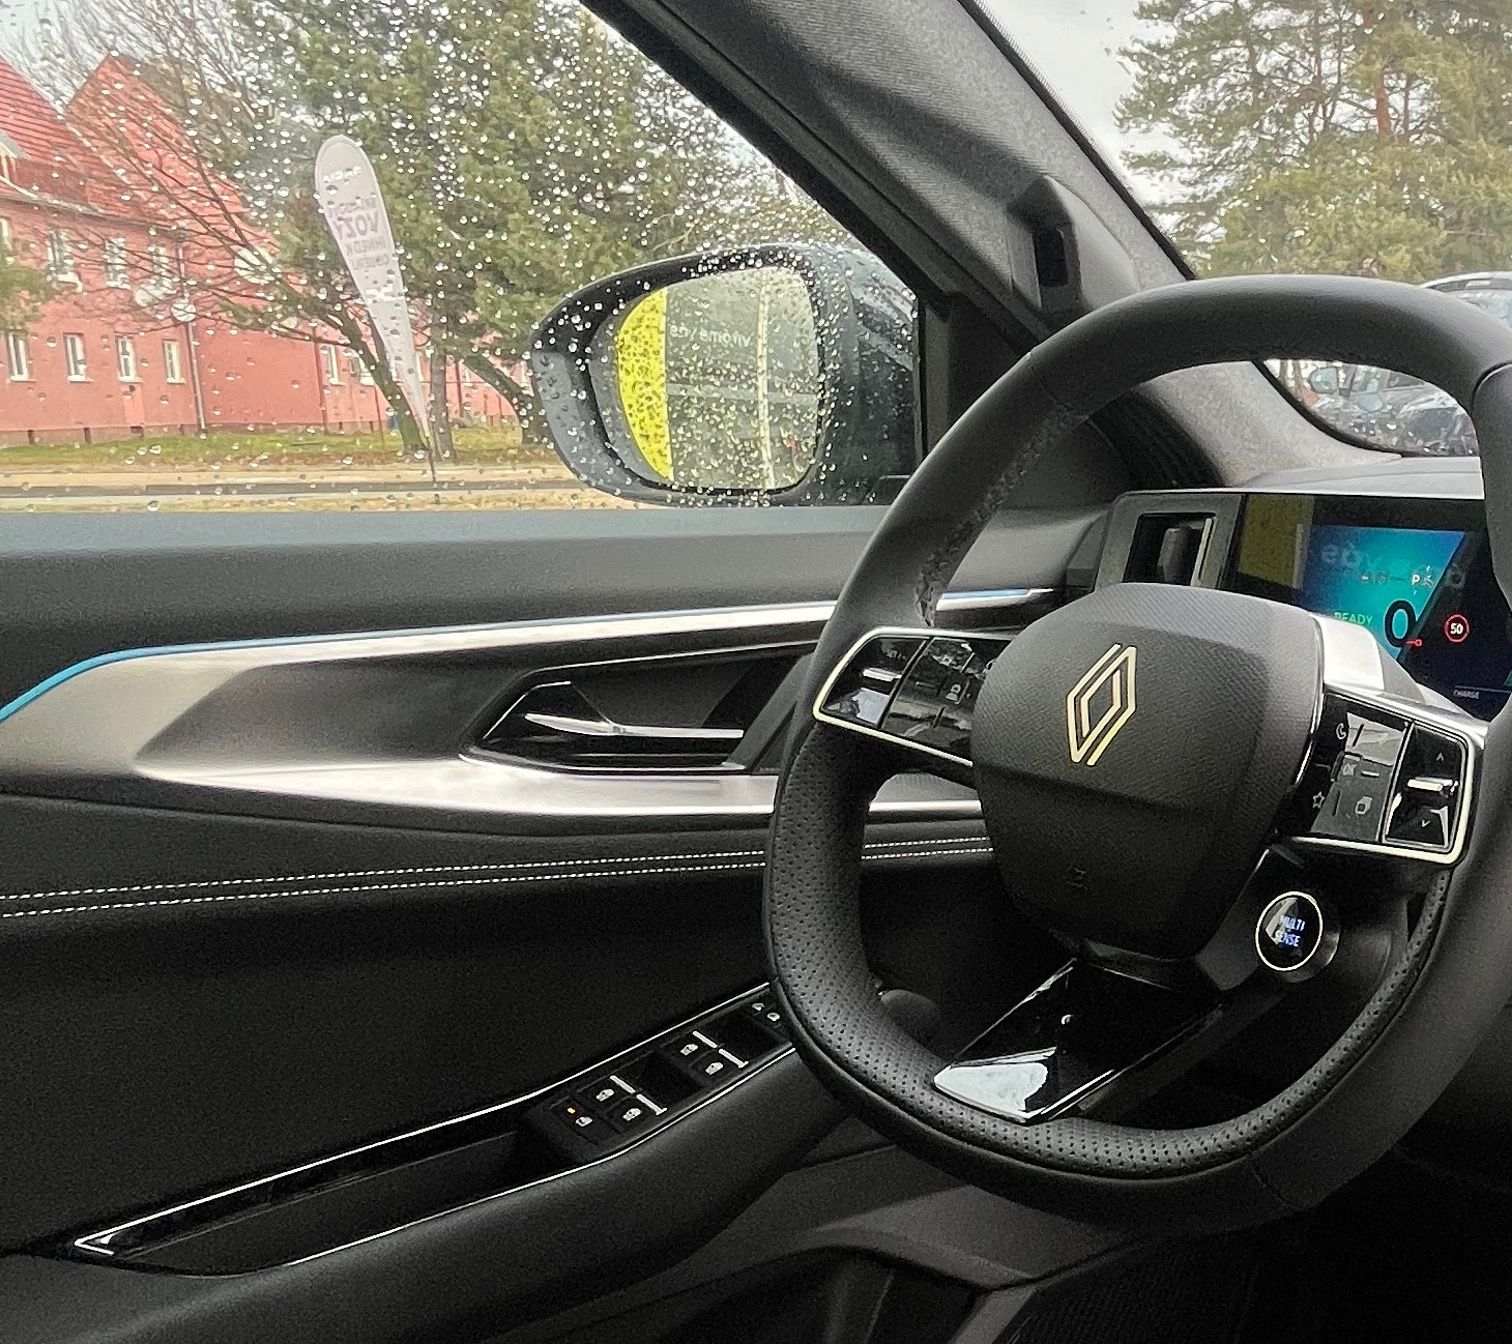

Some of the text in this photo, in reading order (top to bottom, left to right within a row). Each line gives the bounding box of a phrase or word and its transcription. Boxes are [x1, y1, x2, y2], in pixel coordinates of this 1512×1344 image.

[1333, 611, 1373, 625] READY
[1383, 598, 1418, 649] 0
[1449, 622, 1464, 636] 50
